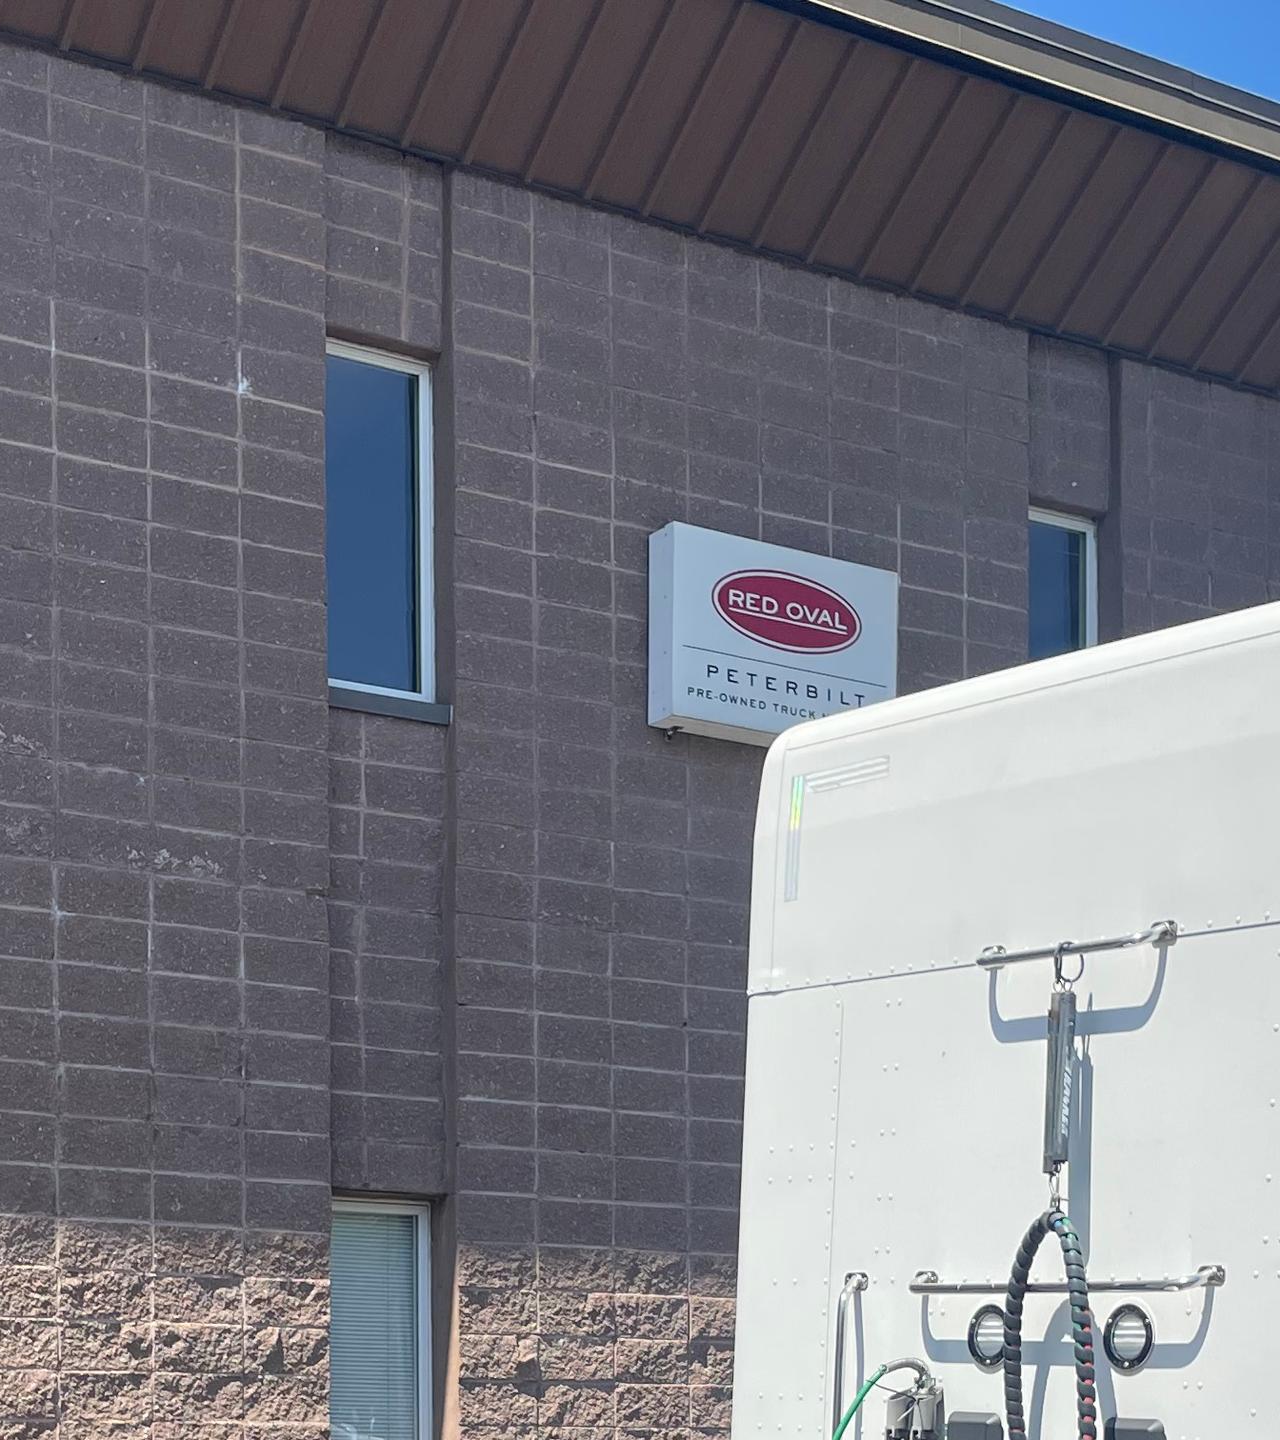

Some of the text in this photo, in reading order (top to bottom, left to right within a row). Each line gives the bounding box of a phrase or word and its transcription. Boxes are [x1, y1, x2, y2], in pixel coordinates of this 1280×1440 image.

[728, 588, 848, 631] RED OVAL
[687, 686, 817, 720] PRE-OWNED TRUCK
[706, 664, 866, 708] PETERBILT
